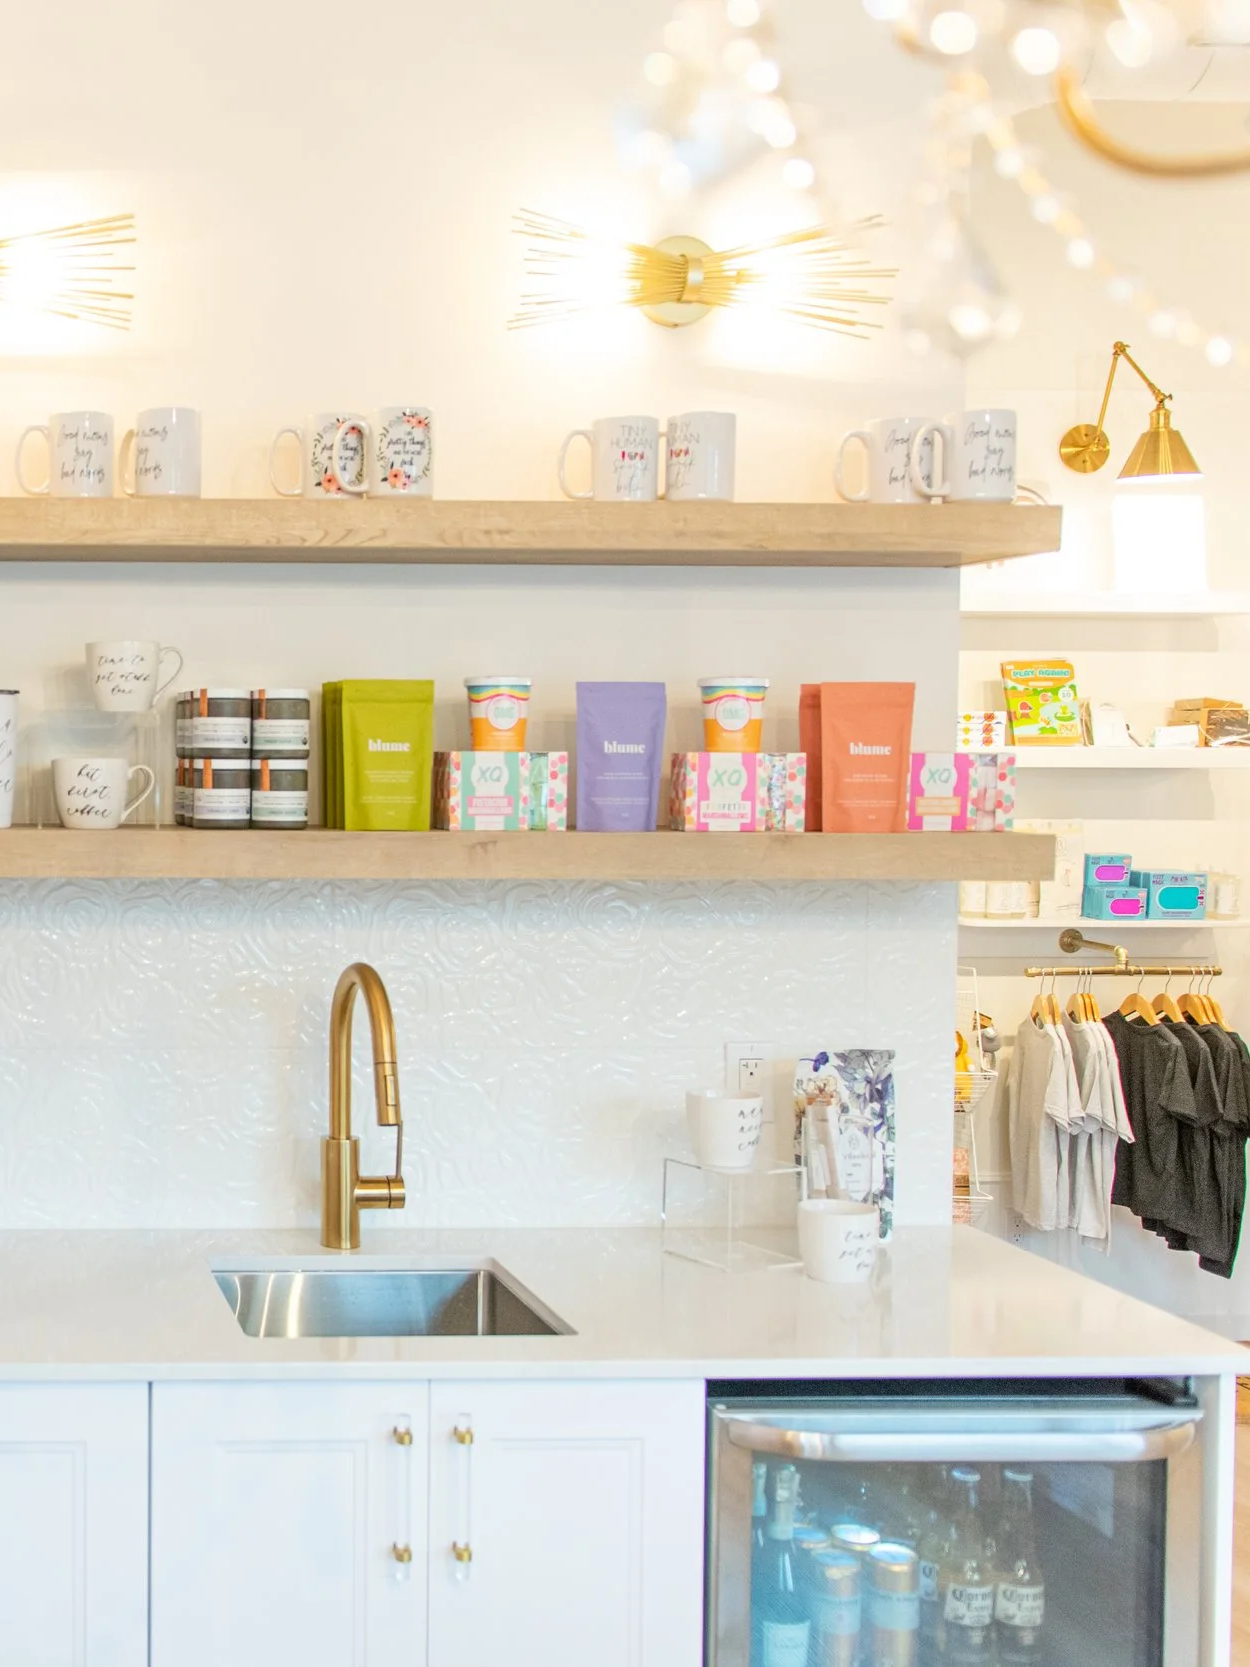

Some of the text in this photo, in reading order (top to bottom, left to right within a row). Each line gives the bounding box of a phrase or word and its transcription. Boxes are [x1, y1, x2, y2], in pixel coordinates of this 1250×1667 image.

[620, 424, 647, 437] TINY
[610, 437, 653, 450] HUMAN
[1012, 667, 1071, 678] PLAY AGAIN!
[367, 738, 411, 753] blume
[603, 740, 646, 754] blume
[849, 742, 892, 756] blume
[66, 803, 112, 819] coffee
